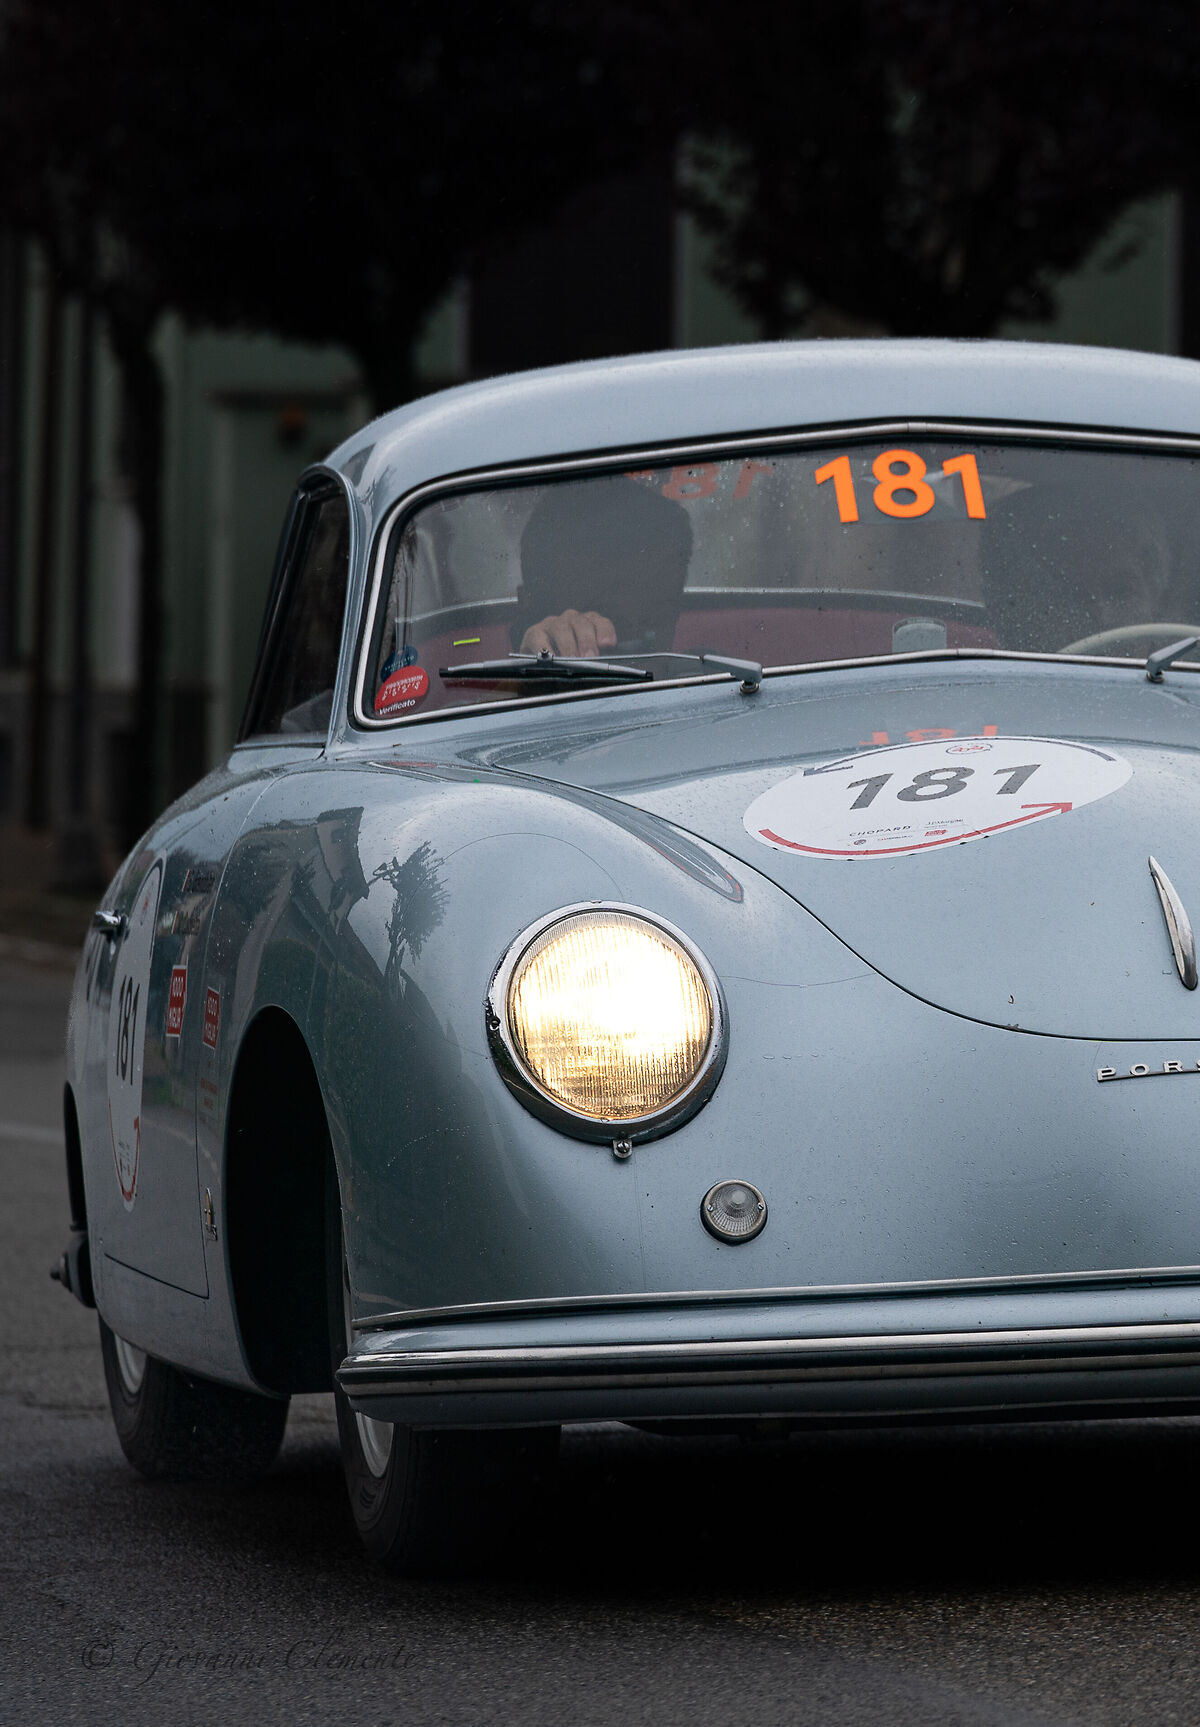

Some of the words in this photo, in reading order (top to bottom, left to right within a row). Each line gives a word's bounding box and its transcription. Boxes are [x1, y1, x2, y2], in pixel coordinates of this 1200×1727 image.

[814, 449, 987, 524] 181
[379, 699, 416, 715] Verificato
[846, 764, 1042, 810] 181
[849, 825, 912, 837] CHOPARD
[115, 974, 141, 1086] 181
